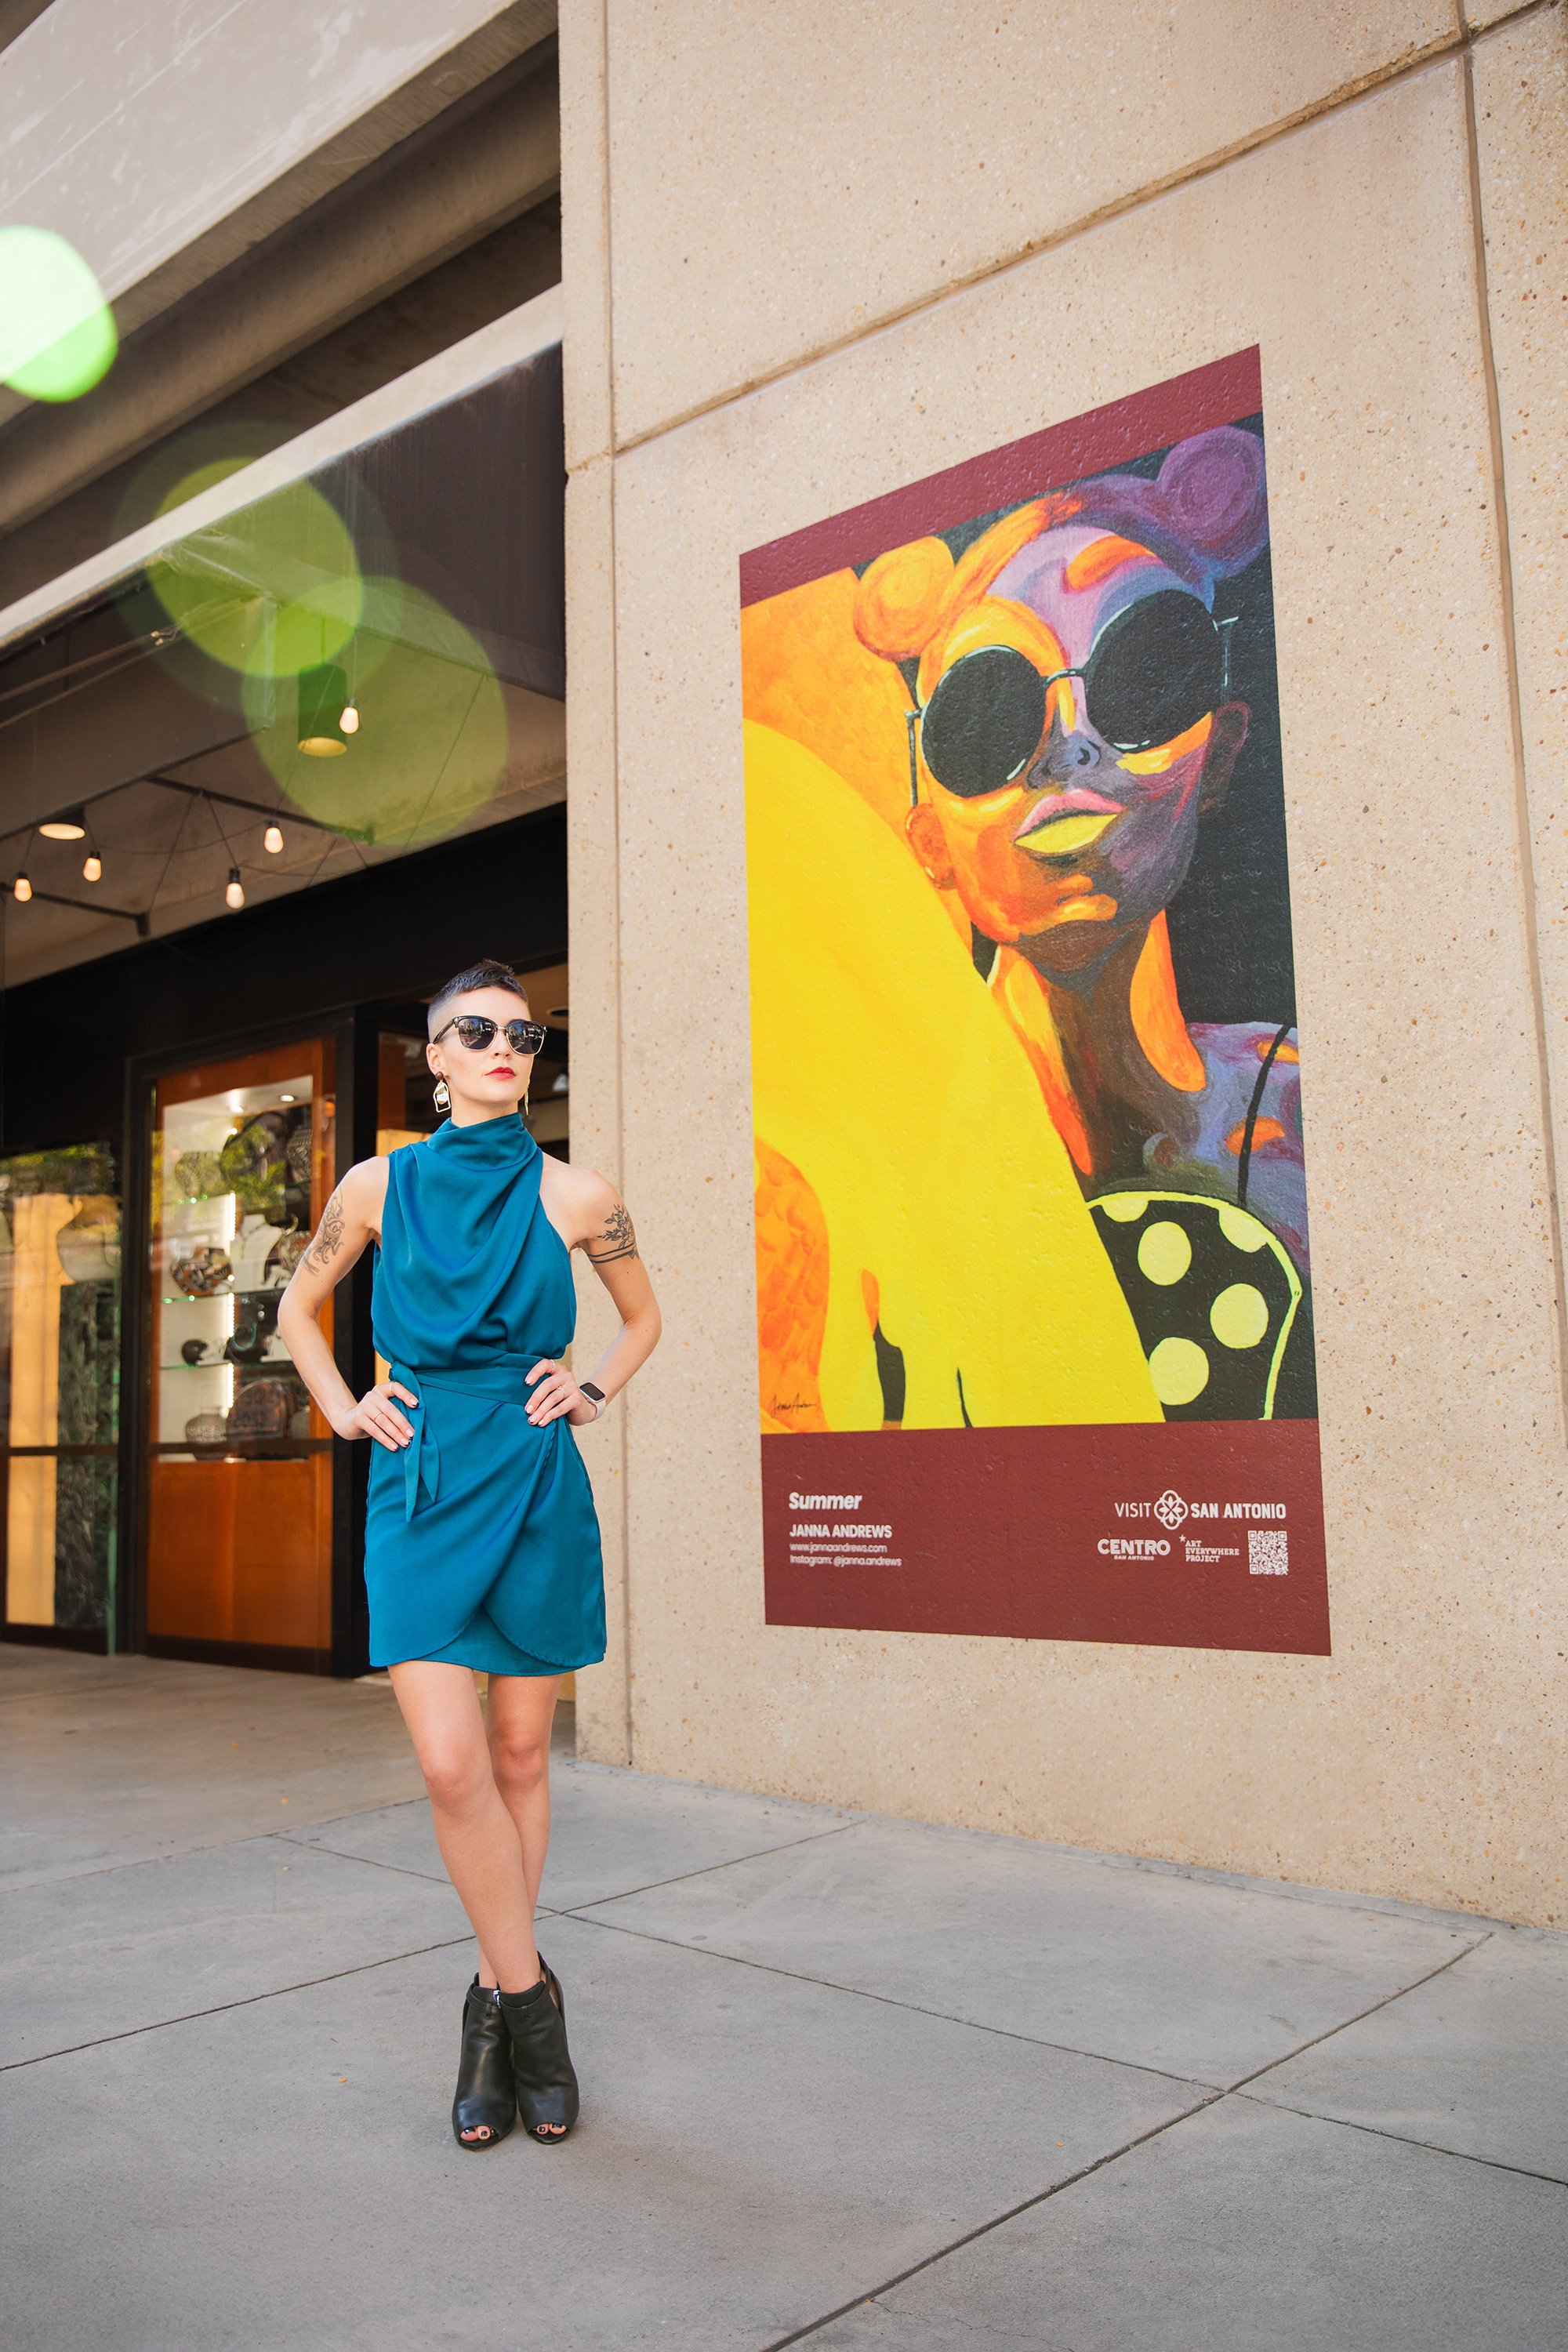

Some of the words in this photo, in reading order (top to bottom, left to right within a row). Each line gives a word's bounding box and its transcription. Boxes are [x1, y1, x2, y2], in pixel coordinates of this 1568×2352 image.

[789, 1492, 862, 1509] Summer
[1114, 1502, 1152, 1518] VISIT
[1190, 1503, 1219, 1518] SAN
[1222, 1503, 1287, 1519] ANTONIO
[789, 1524, 830, 1537] JANNA
[832, 1525, 892, 1538] ANDREWS
[789, 1542, 887, 1554] www.jannaandrews.com
[1098, 1538, 1171, 1555] CENTRO
